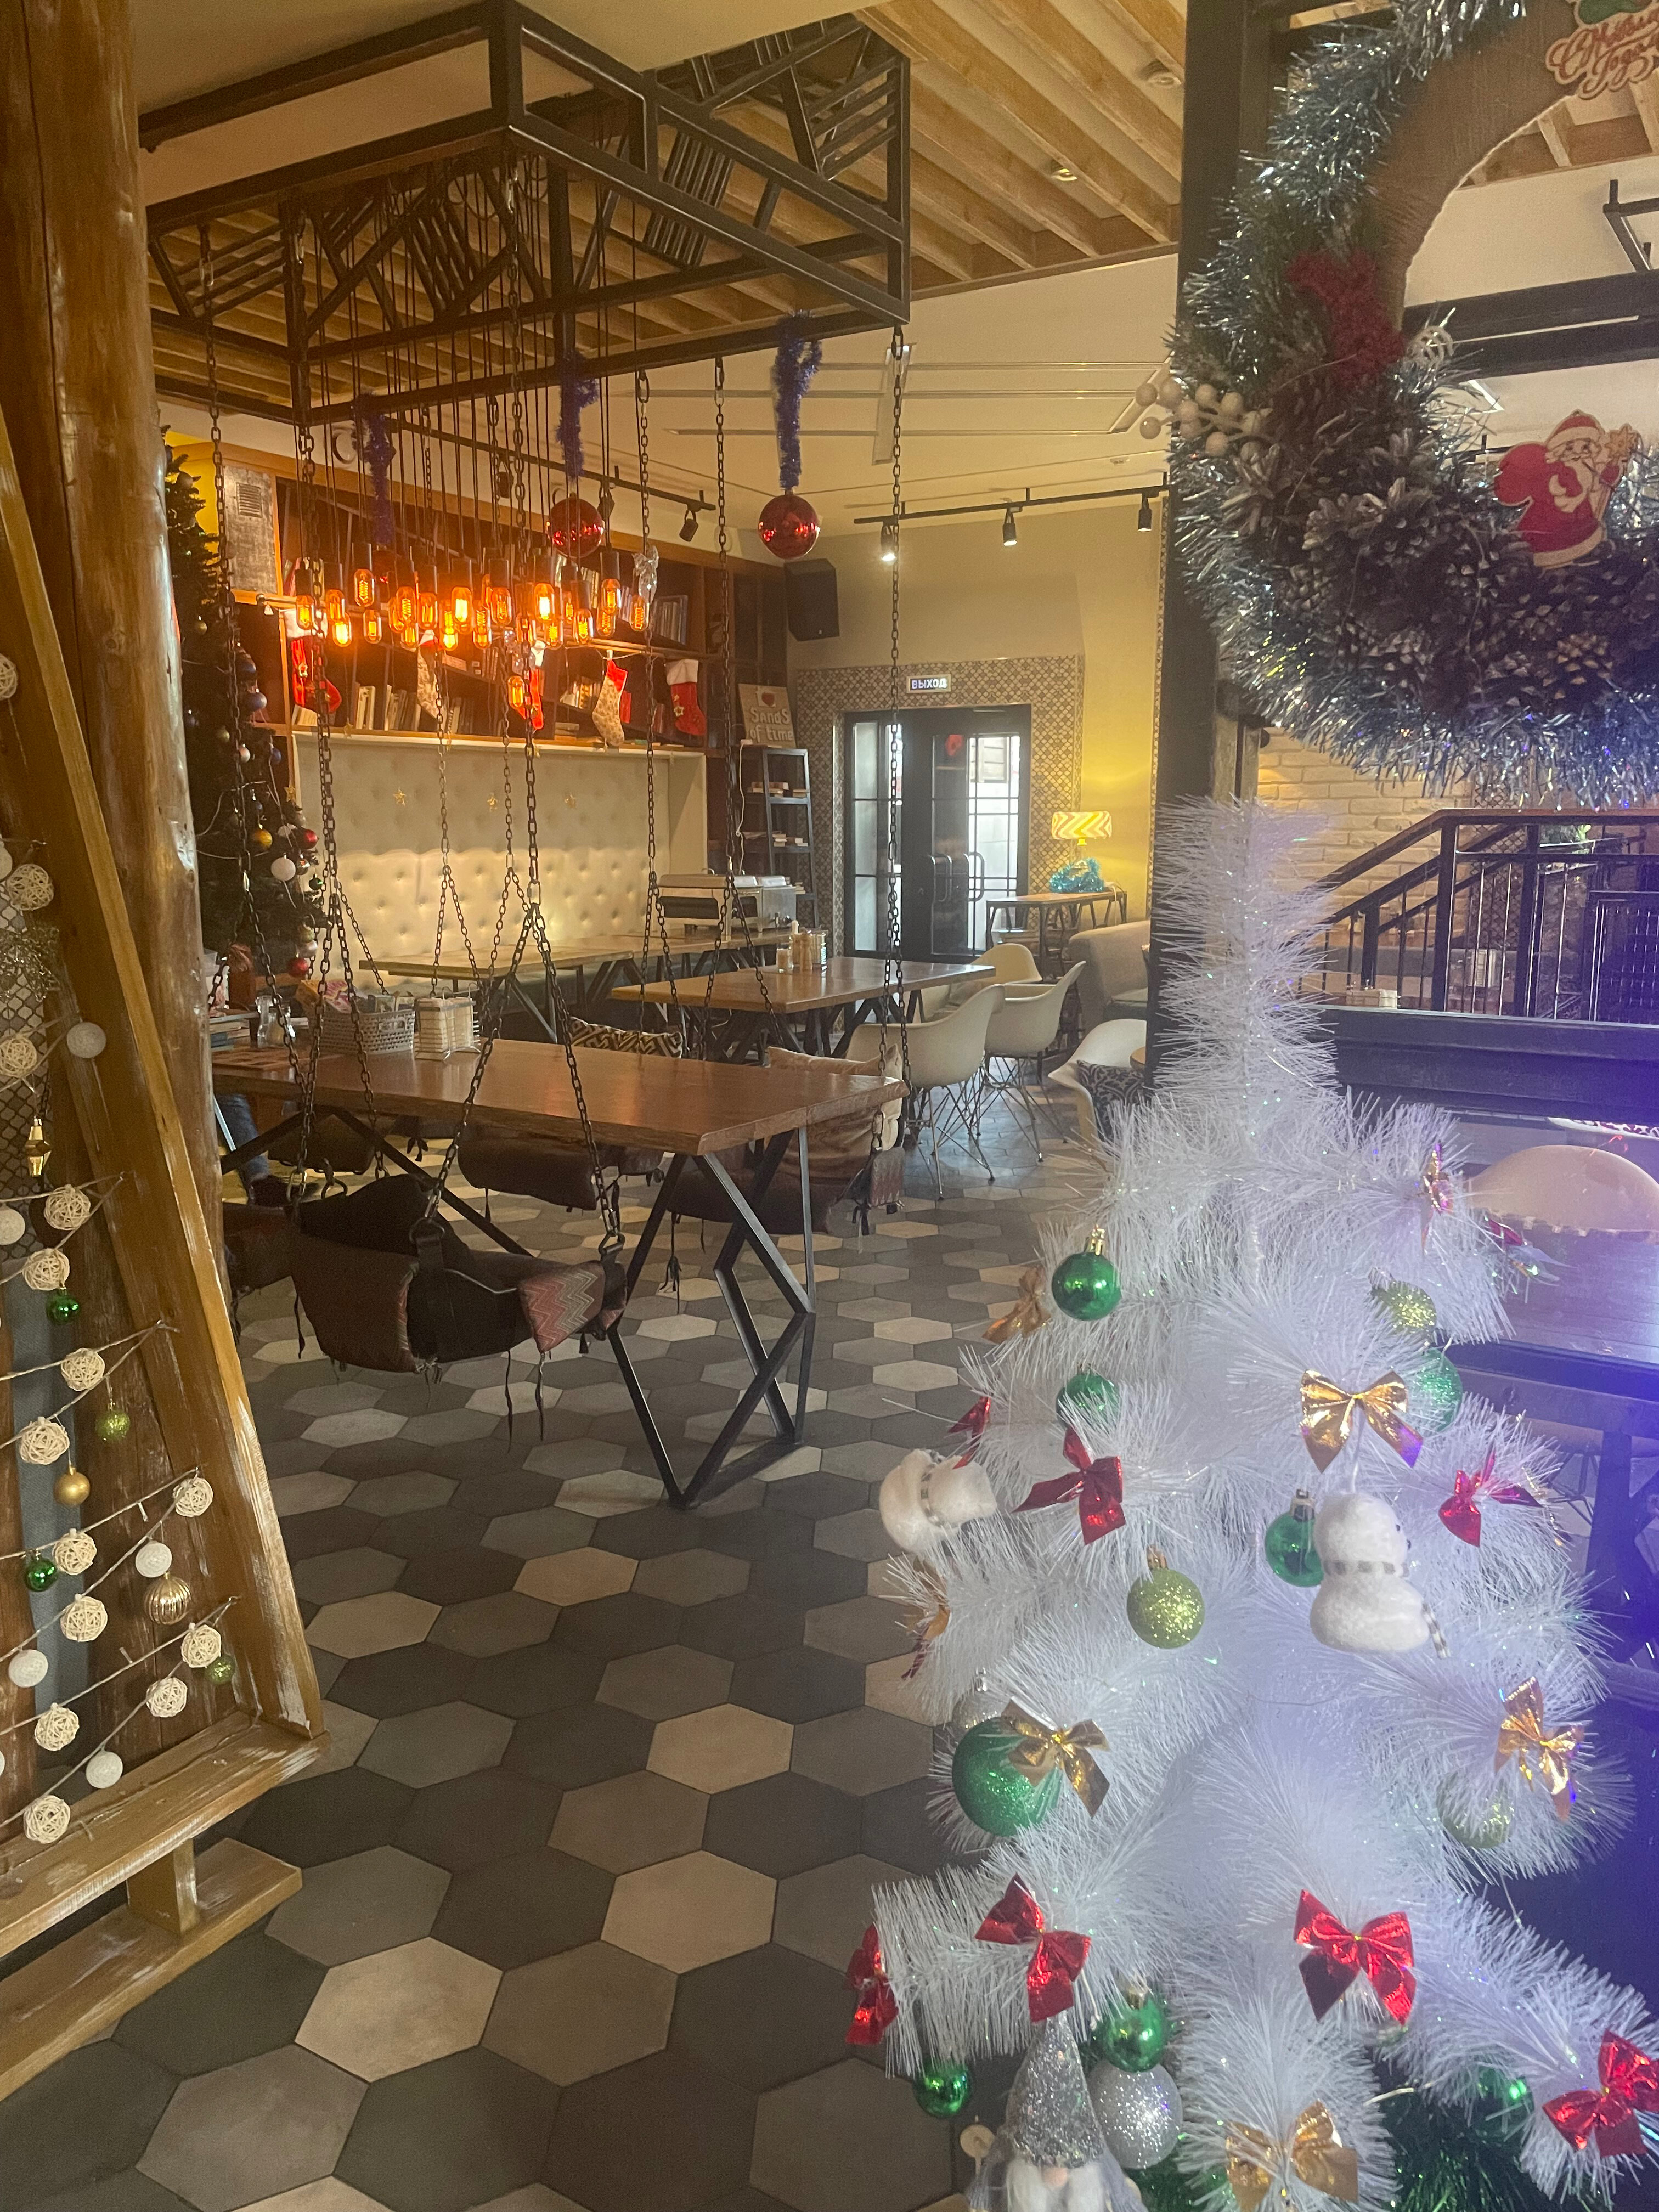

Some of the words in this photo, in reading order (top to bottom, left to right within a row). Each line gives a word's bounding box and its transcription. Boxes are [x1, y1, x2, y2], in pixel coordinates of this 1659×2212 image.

[911, 678, 947, 689] ВЫХОД
[749, 724, 761, 742] of
[766, 725, 794, 741] time
